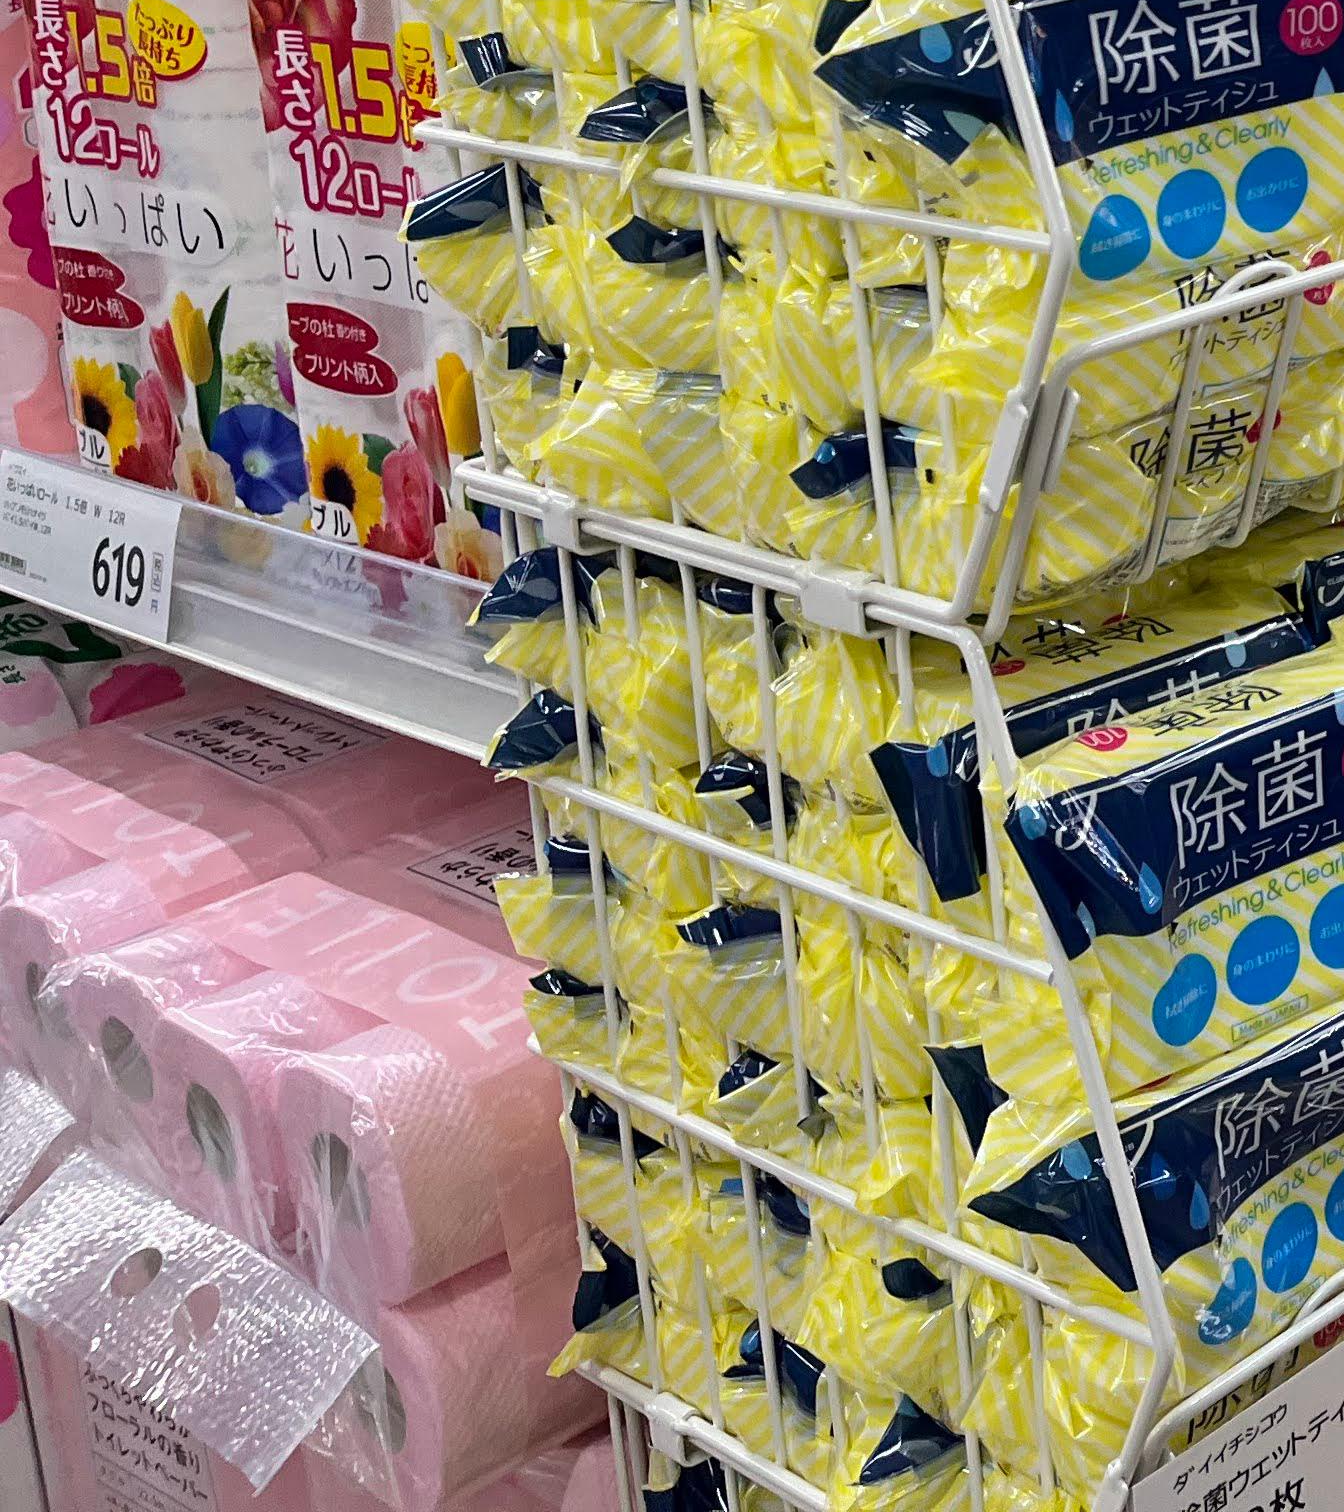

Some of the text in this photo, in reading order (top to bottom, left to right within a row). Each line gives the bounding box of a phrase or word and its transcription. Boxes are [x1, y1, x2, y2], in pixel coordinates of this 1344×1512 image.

[133, 0, 194, 48] たっぷり
[137, 37, 182, 71] 長持ち
[1284, 0, 1339, 37] 100
[273, 29, 315, 127] 長さ
[1087, 79, 1280, 146] ウェットティシュ
[47, 92, 160, 178] 12ロール
[92, 536, 146, 608] 619
[1170, 729, 1328, 870] 除菌
[1172, 816, 1343, 909] ウェットティシュ
[1173, 1402, 1288, 1495] ダイイチシコウ
